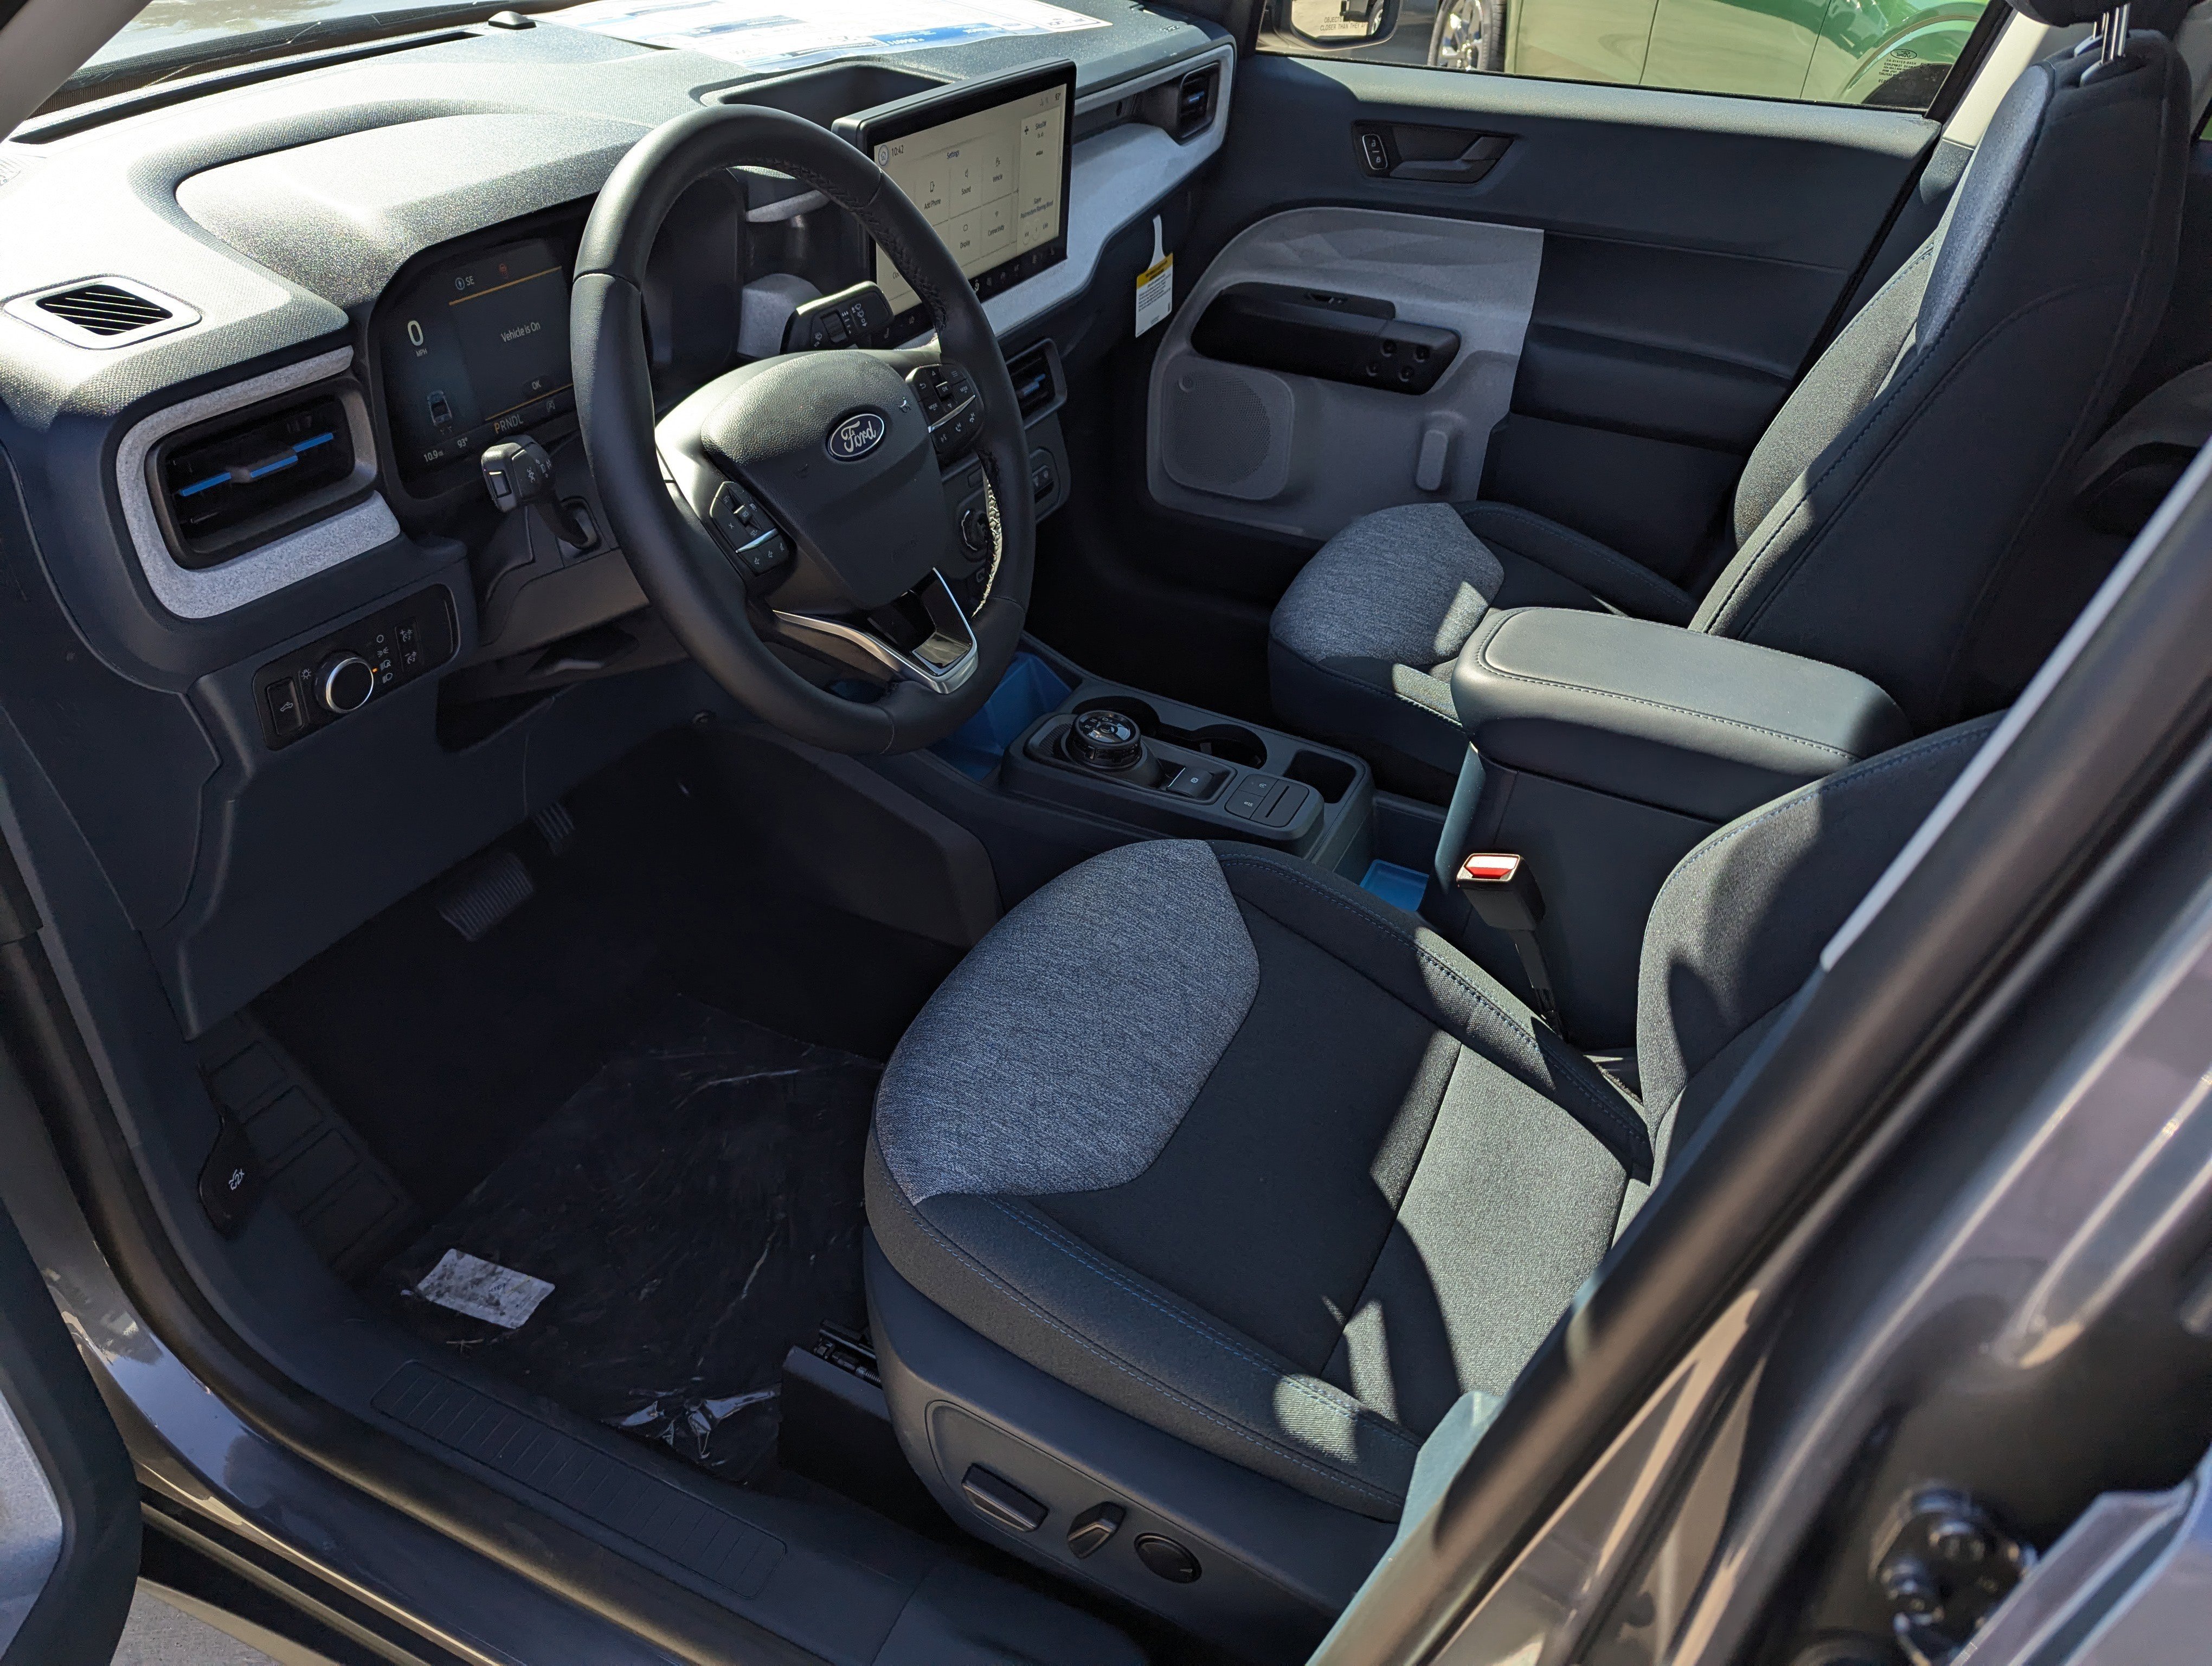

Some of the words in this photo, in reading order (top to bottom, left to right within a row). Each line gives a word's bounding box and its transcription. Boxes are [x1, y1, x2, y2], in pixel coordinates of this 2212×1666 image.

[892, 145, 904, 157] 10:42
[947, 150, 960, 159] Settings
[993, 174, 1003, 182] Vehicle
[961, 186, 972, 195] Sound
[931, 198, 941, 207] Phone
[988, 225, 1005, 236] Connectivity
[408, 320, 423, 346] 0
[500, 327, 525, 342] Vehicle
[524, 325, 531, 334] is
[531, 322, 541, 331] On
[415, 348, 428, 357] MPH
[532, 380, 541, 390] OK
[841, 420, 876, 453] Ford
